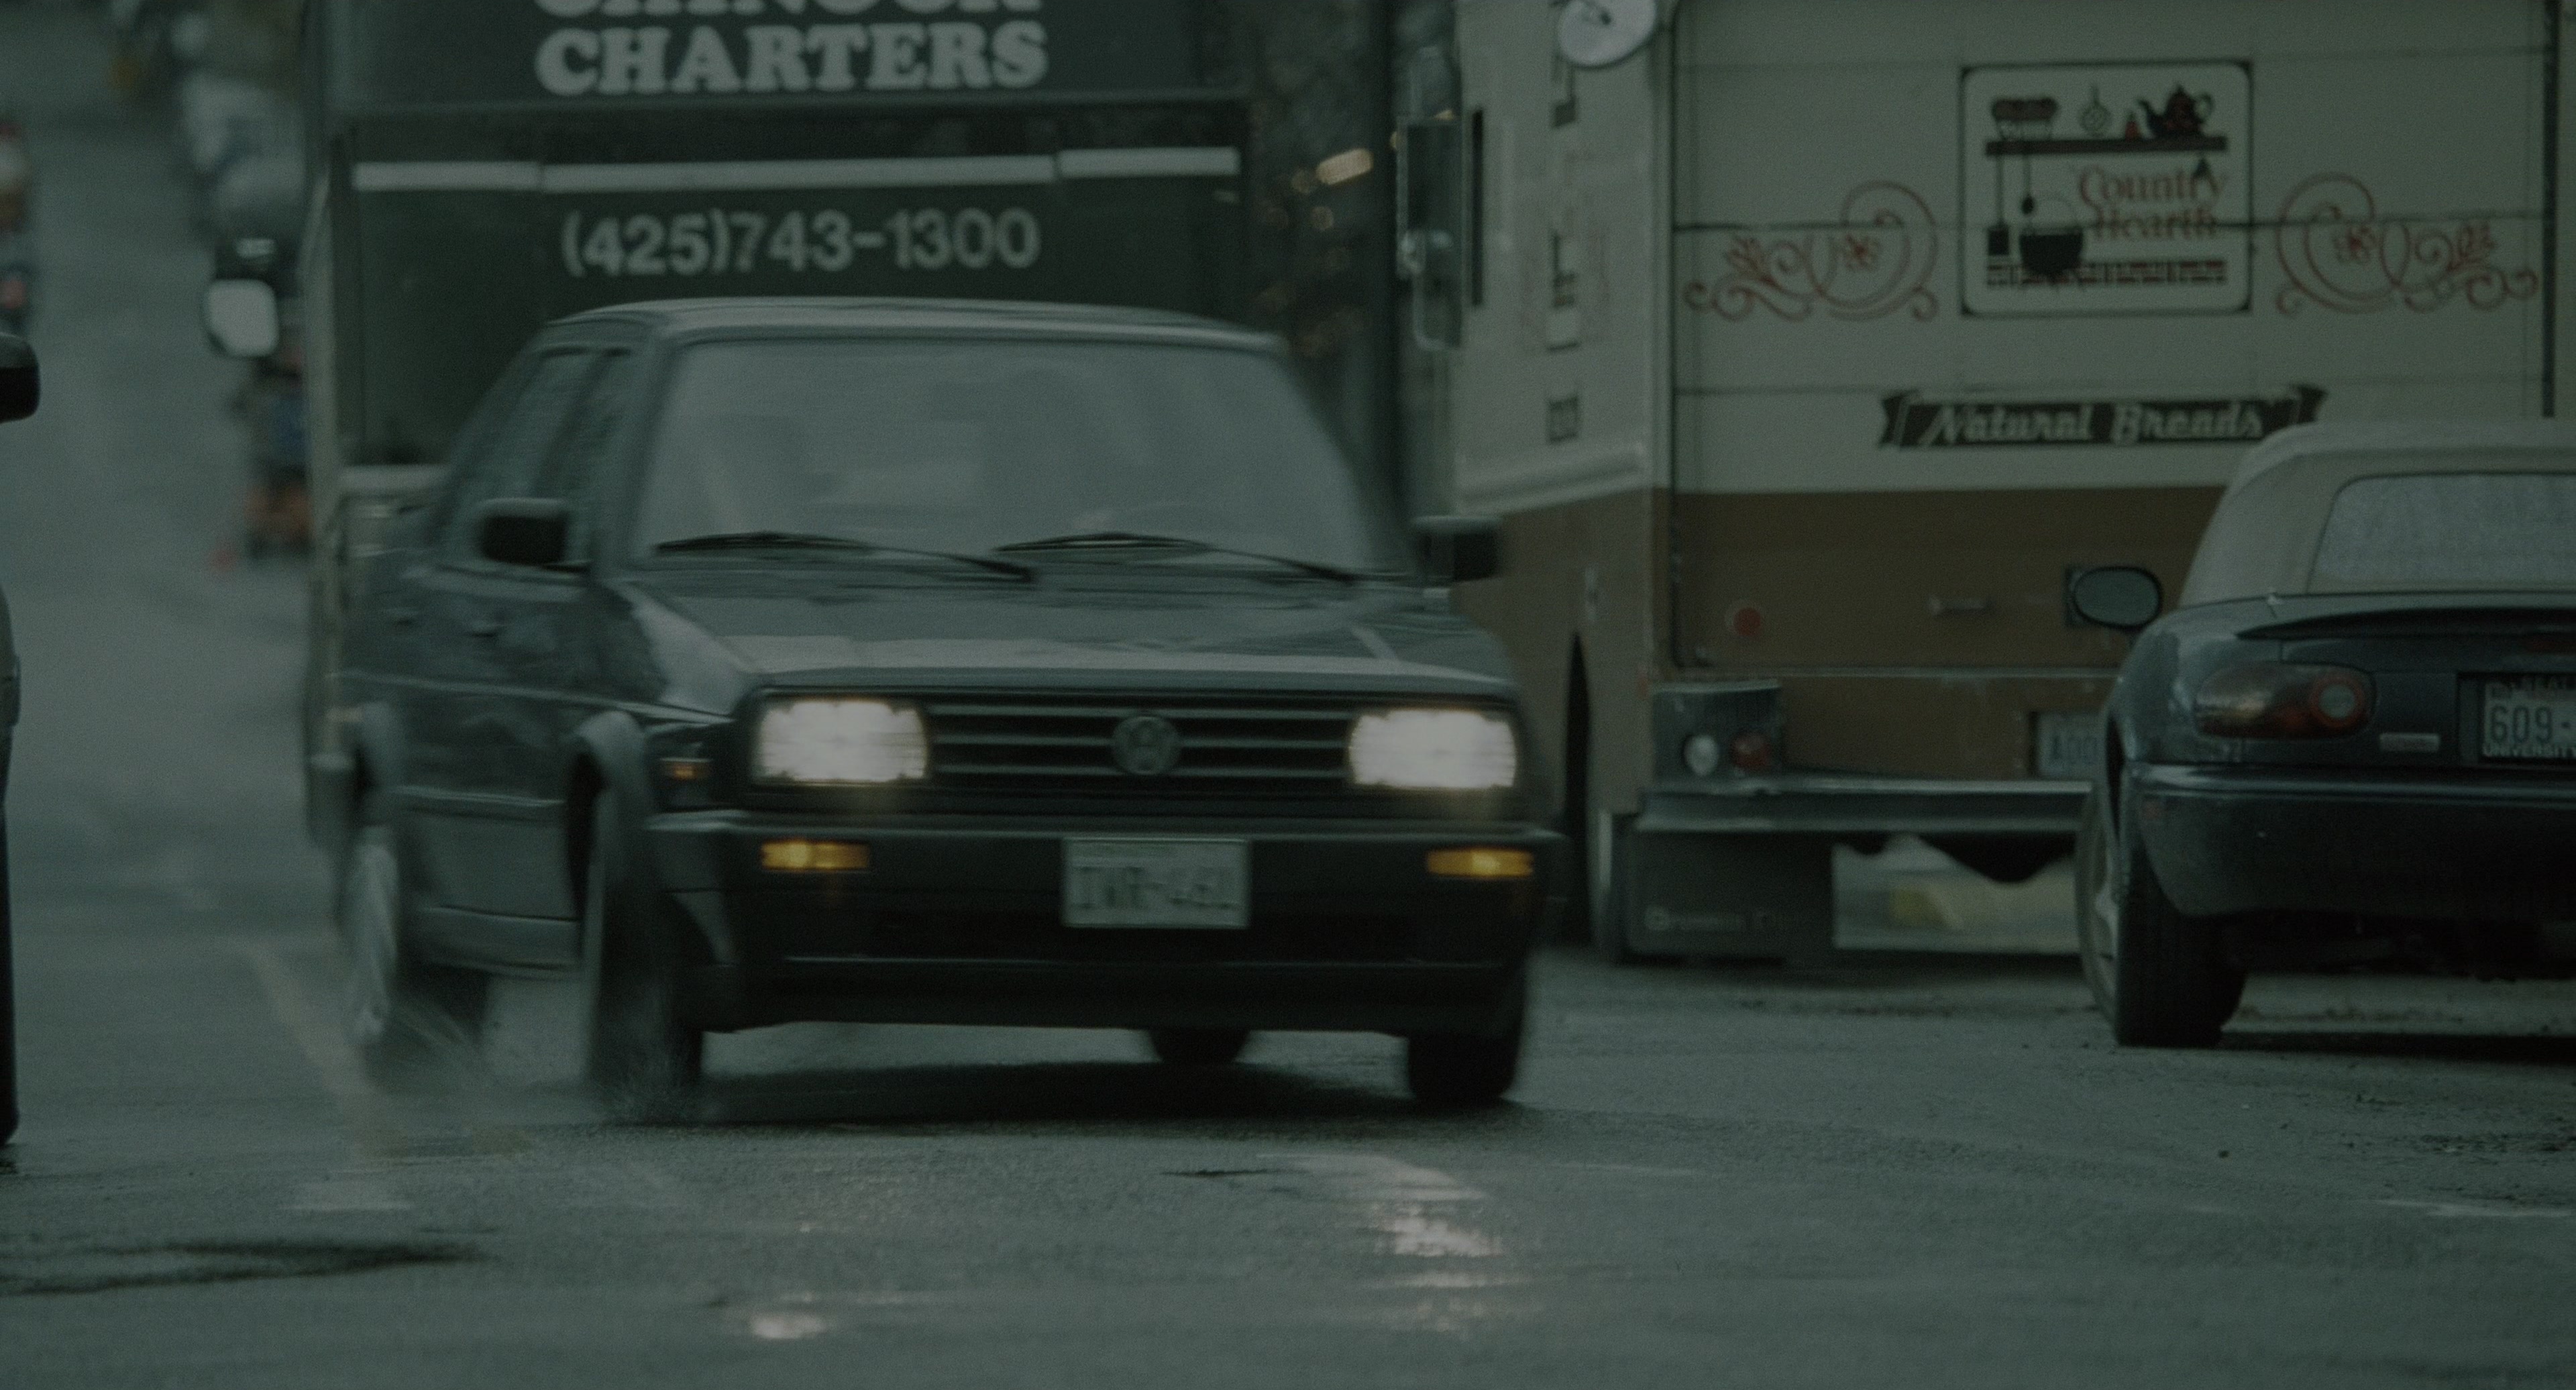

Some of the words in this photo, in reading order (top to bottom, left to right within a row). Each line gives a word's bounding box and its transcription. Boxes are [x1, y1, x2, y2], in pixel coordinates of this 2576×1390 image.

[536, 20, 1049, 95] CHARTERS
[2079, 166, 2226, 208] Country
[561, 207, 1042, 277] (425)743-1300
[1917, 400, 2094, 447] Natural
[2110, 400, 2263, 445] Breads
